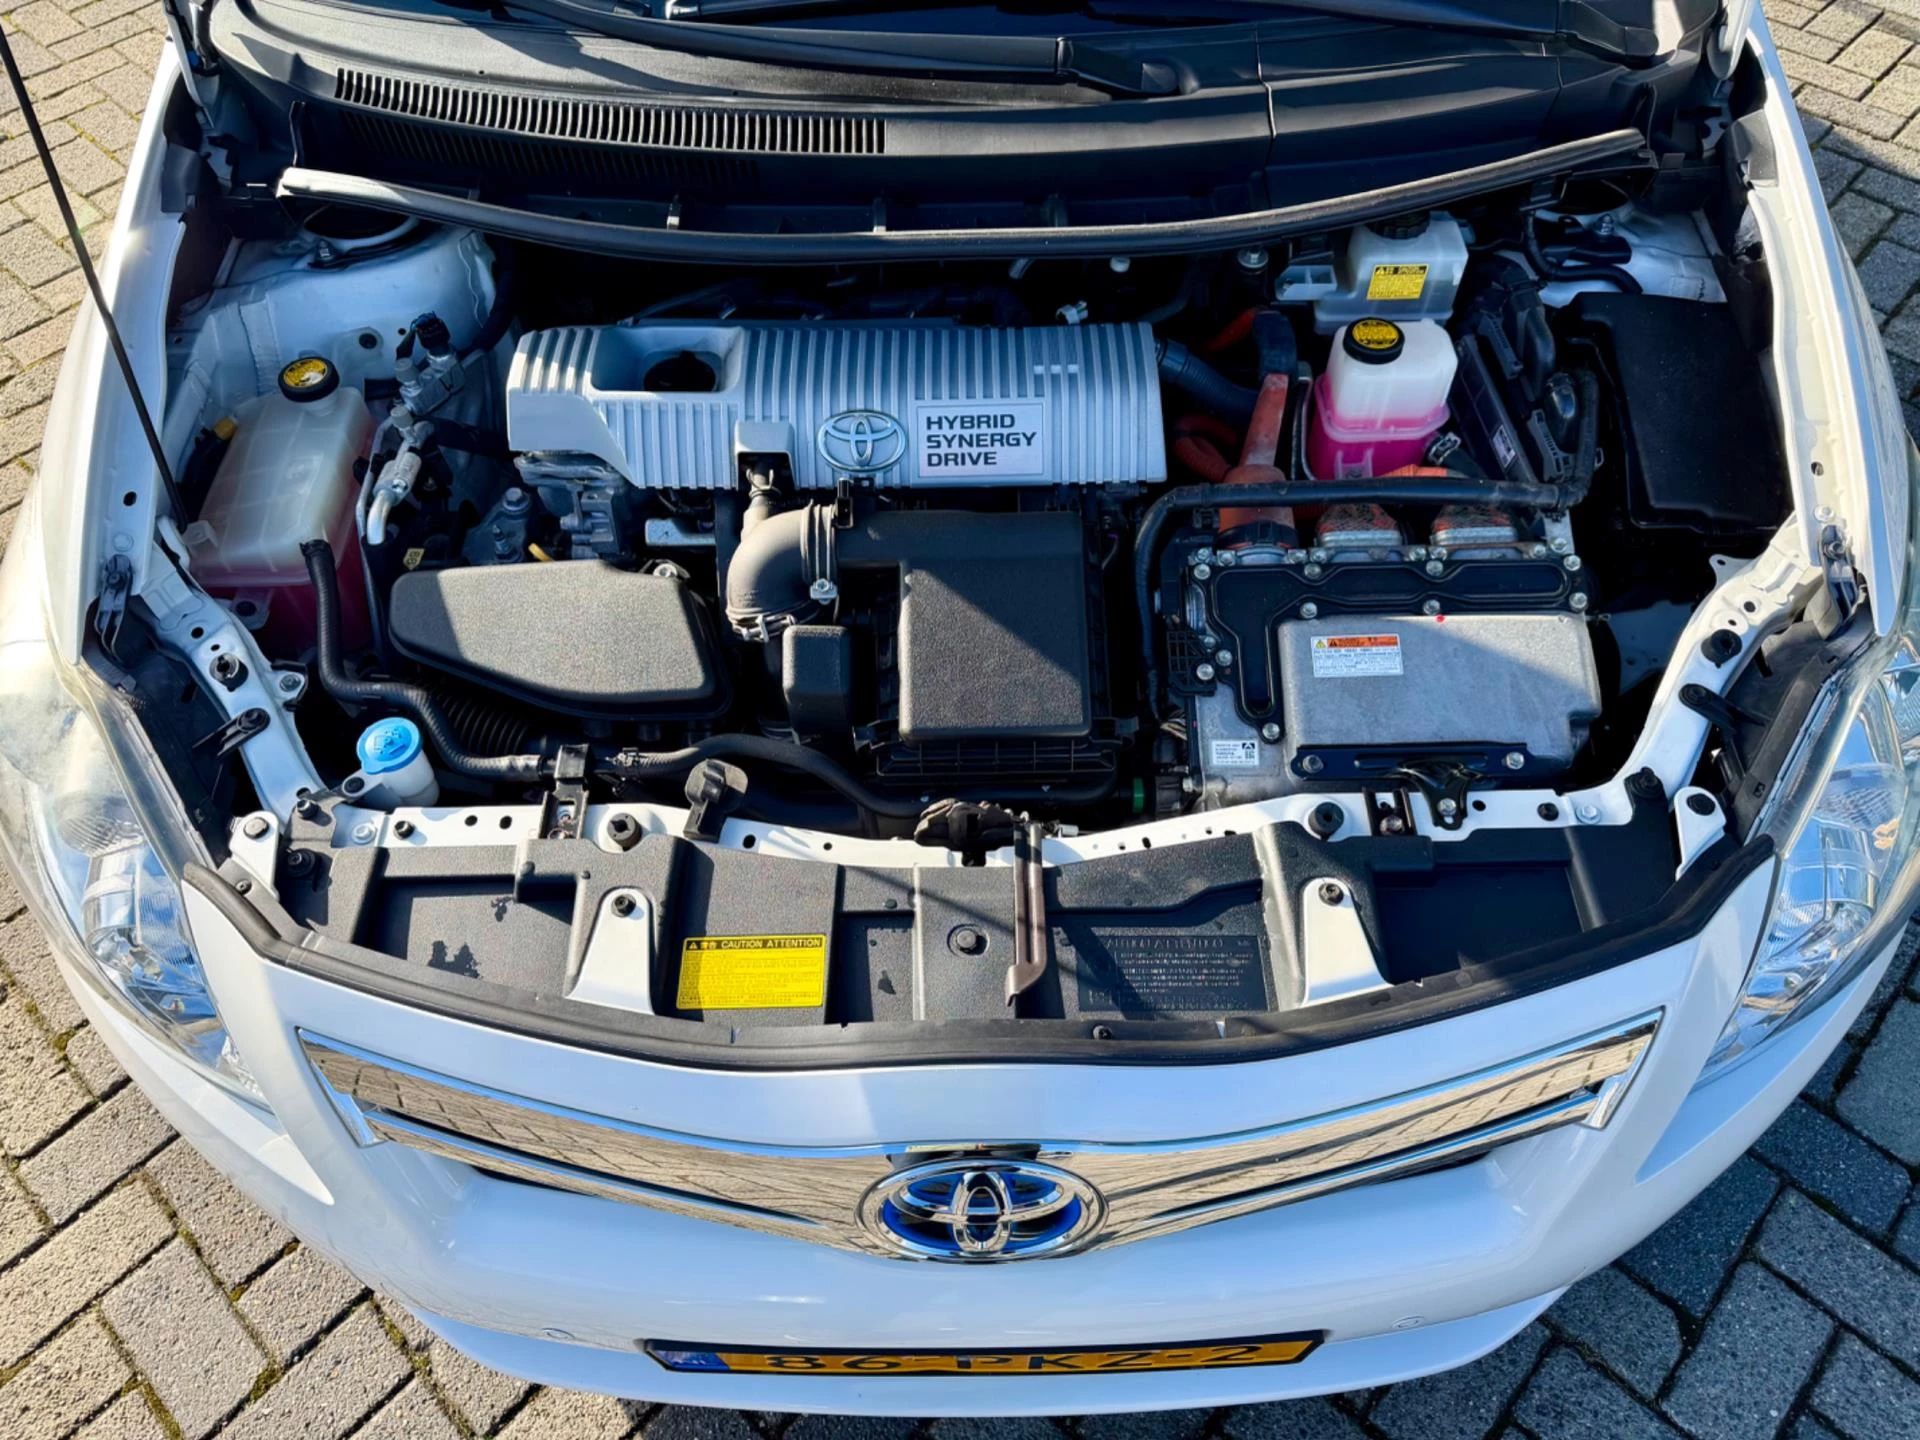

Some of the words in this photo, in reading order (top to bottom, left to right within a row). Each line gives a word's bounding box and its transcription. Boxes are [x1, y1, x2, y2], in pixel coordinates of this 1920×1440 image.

[926, 413, 1016, 430] HYBRID
[926, 432, 1037, 449] SYNERGY
[927, 451, 998, 467] DRIVE
[721, 940, 763, 950] CAUTION
[766, 938, 821, 949] ATTENTION
